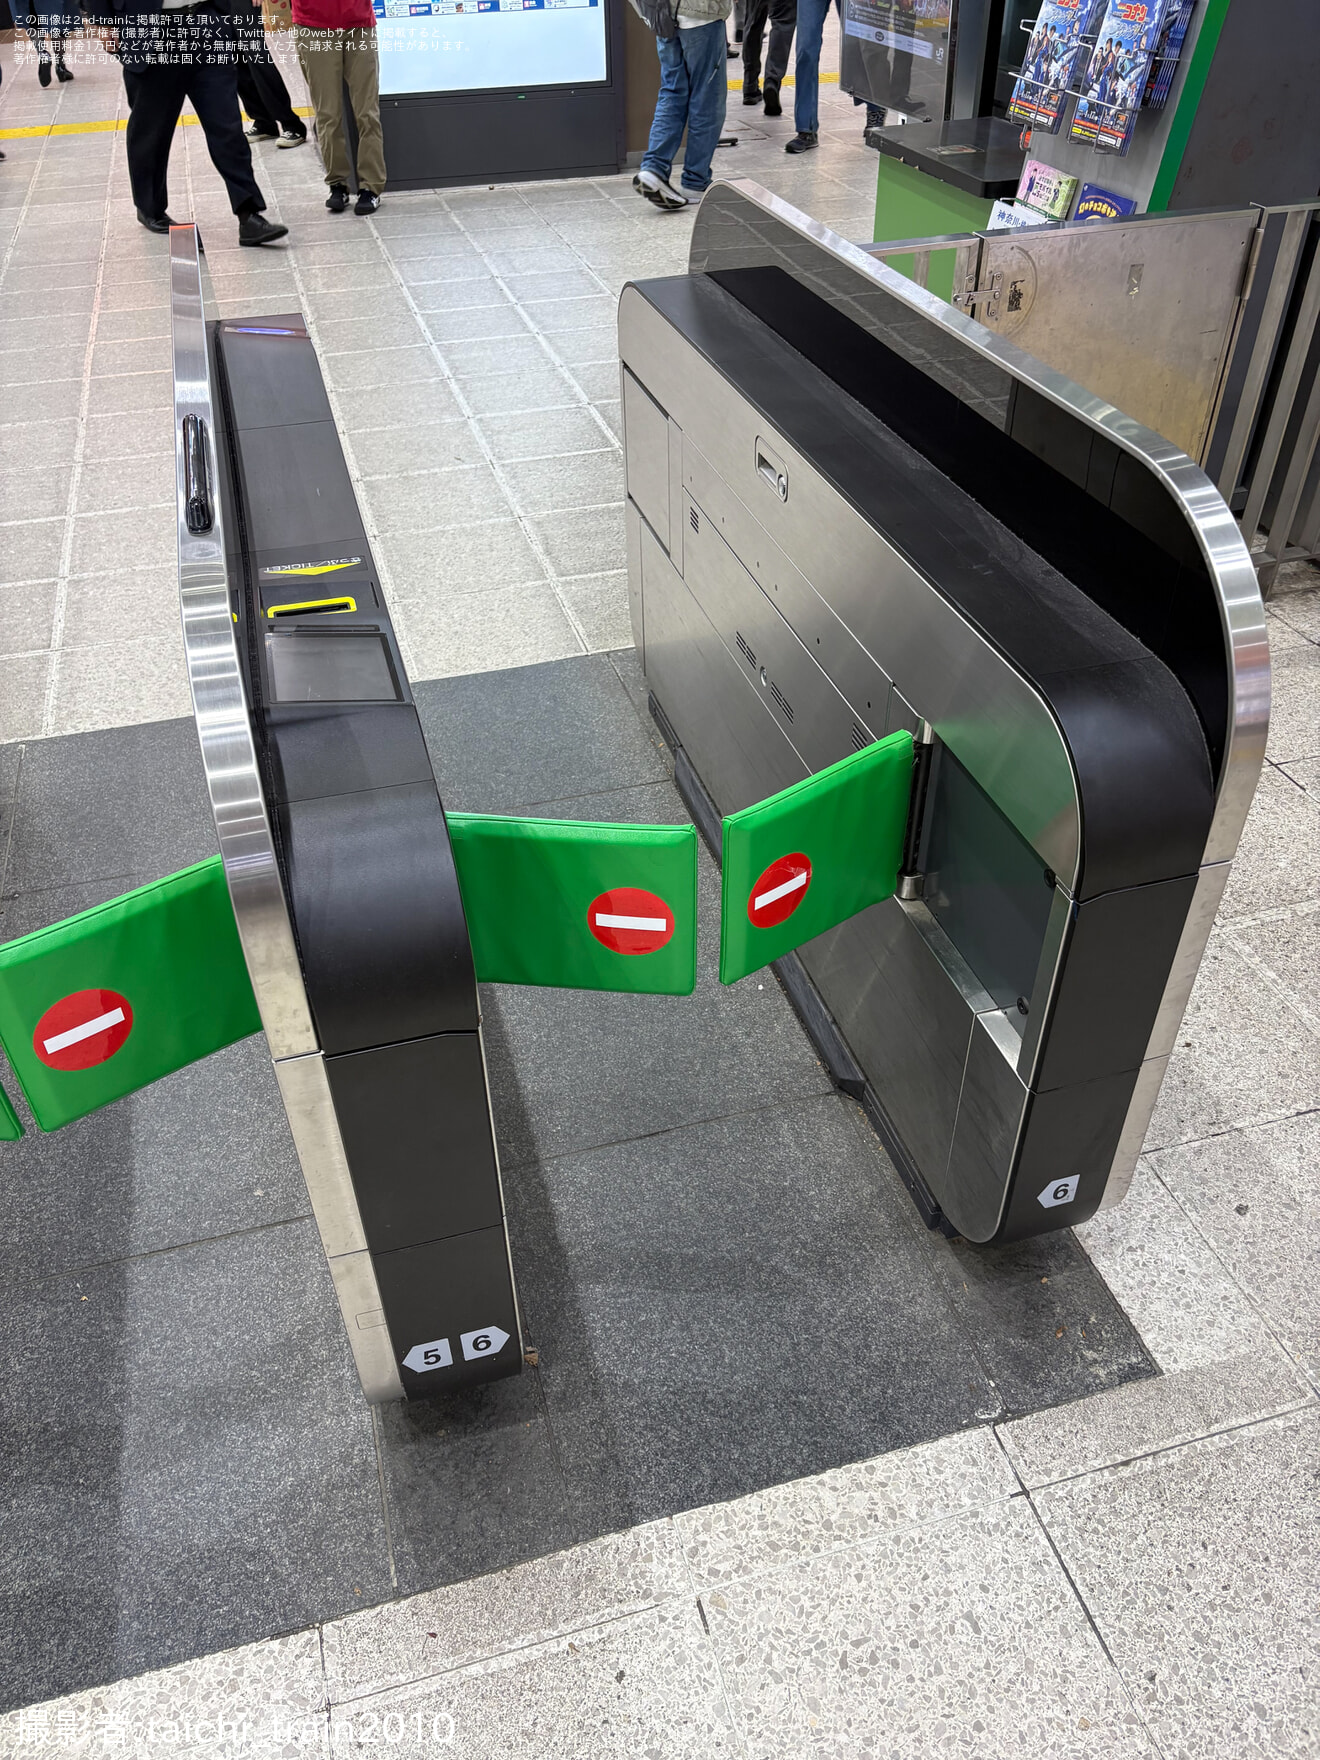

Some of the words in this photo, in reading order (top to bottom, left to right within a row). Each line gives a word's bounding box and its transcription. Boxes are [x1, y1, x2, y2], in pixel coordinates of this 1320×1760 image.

[1053, 1183, 1069, 1200] 6
[472, 1335, 491, 1351] 6
[424, 1348, 441, 1365] 5
